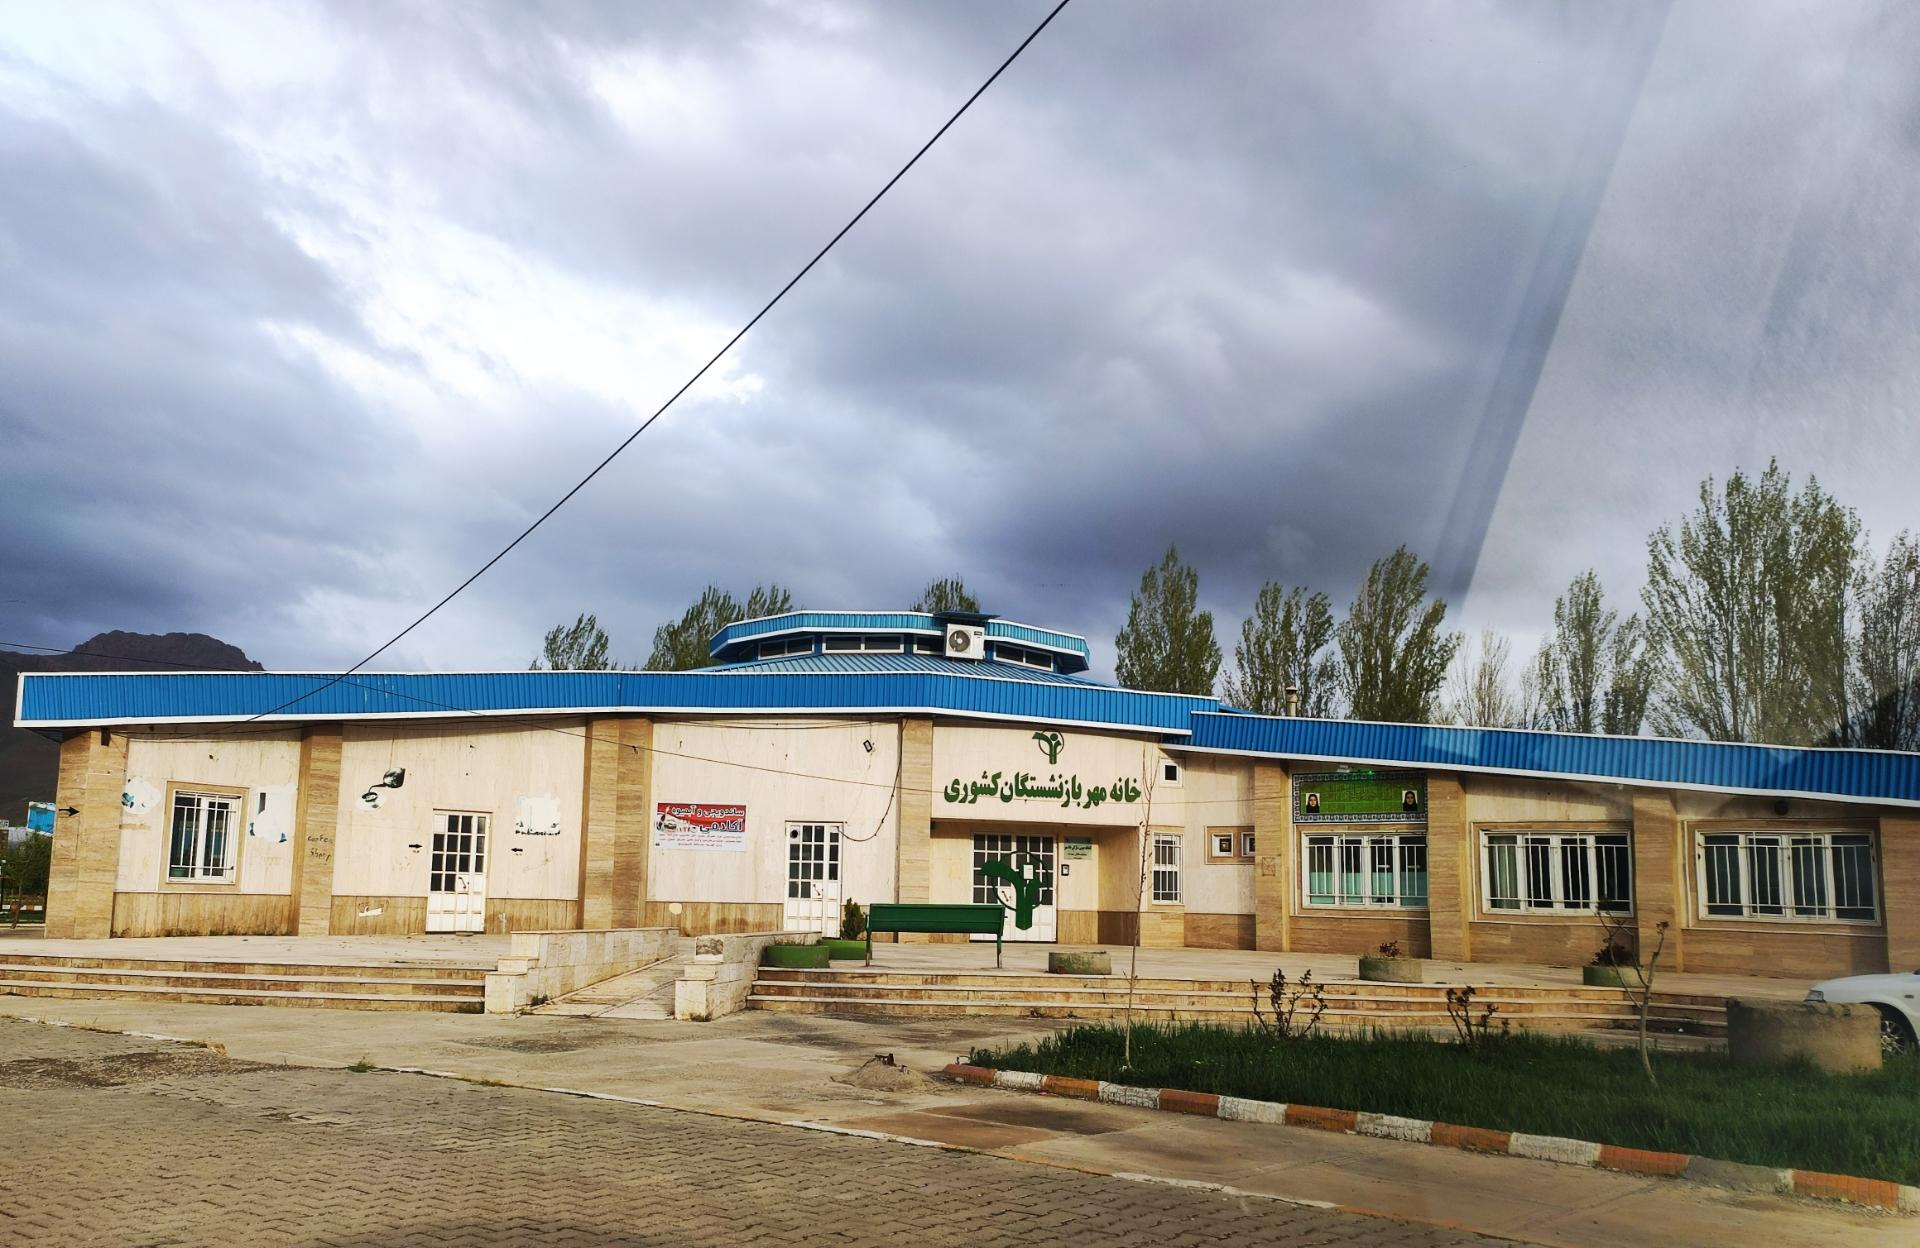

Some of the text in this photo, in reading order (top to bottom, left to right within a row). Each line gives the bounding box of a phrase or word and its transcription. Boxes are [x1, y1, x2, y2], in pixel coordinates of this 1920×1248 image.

[943, 770, 1141, 808] خانه مهر بازنشستگان کشوری
[696, 807, 703, 816] و
